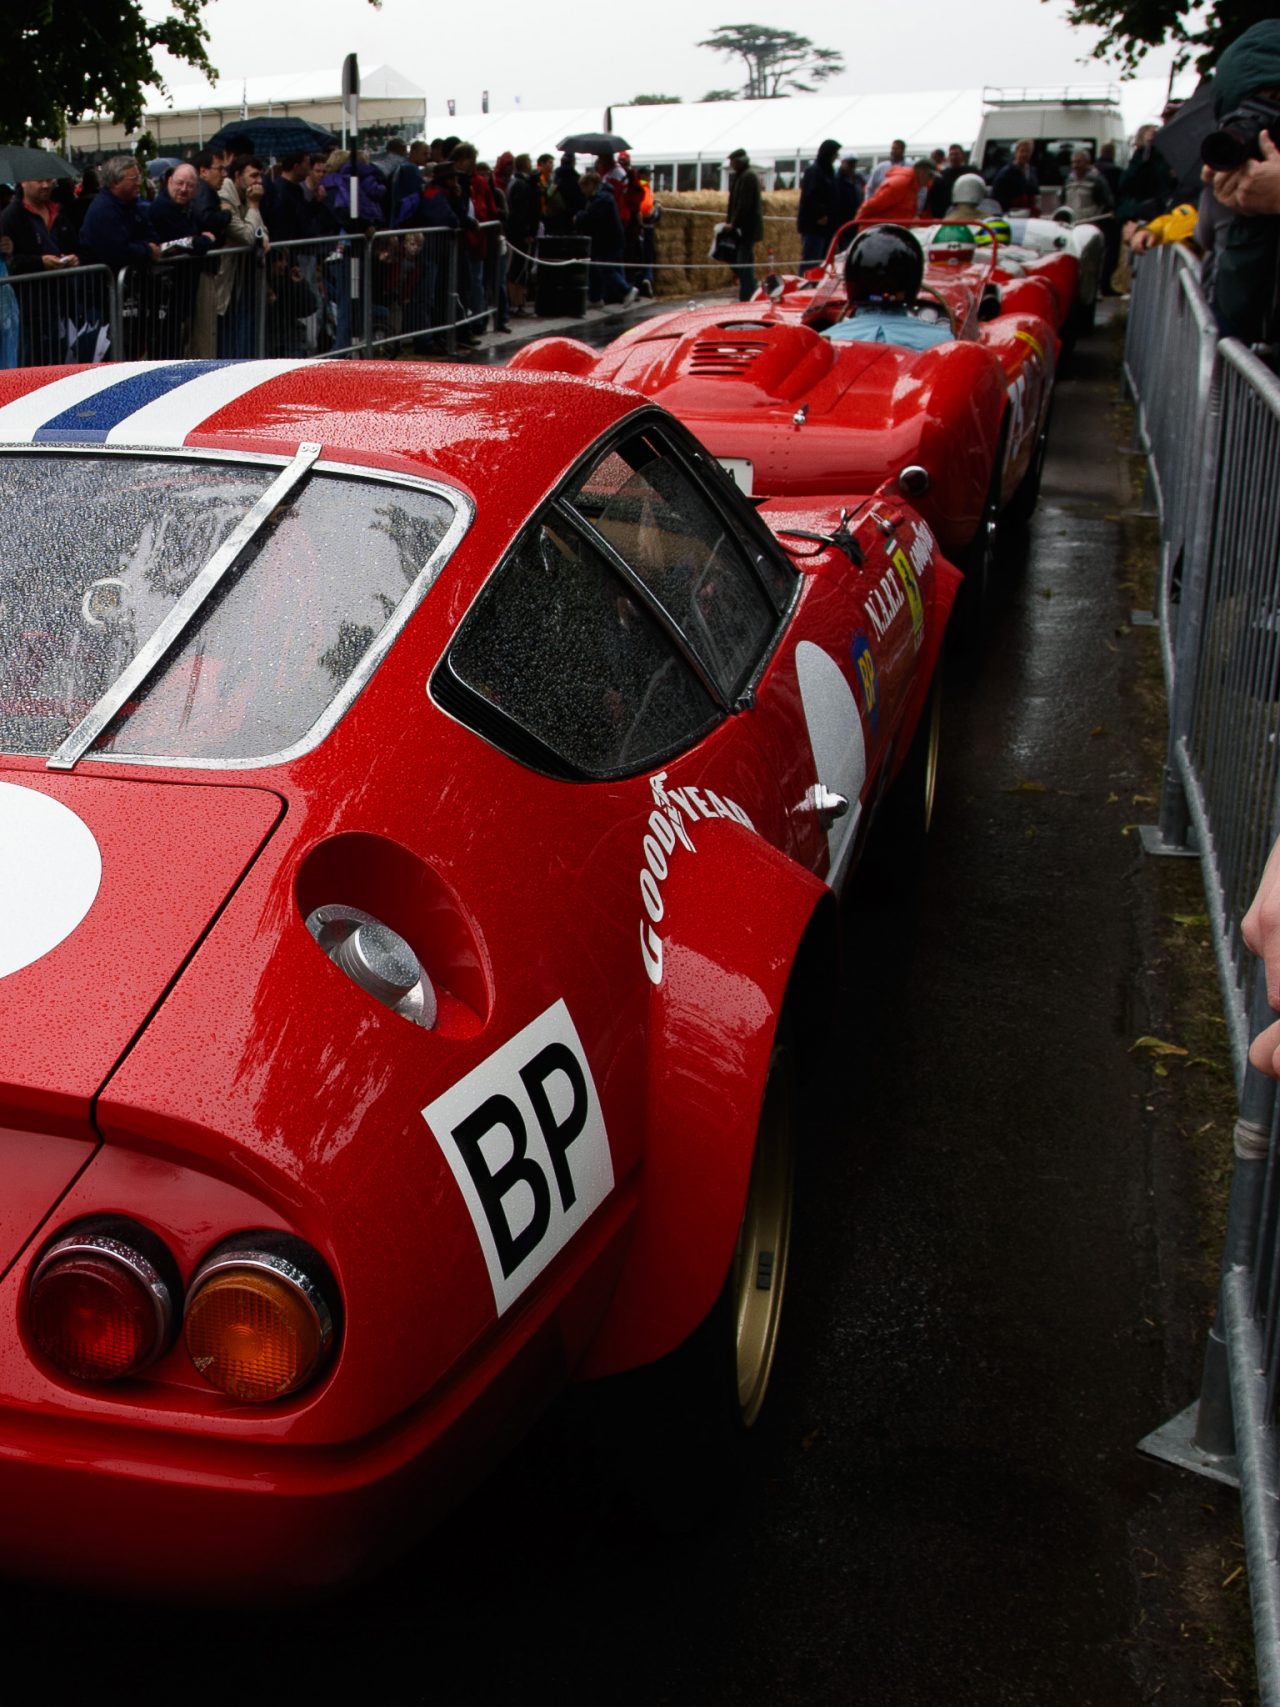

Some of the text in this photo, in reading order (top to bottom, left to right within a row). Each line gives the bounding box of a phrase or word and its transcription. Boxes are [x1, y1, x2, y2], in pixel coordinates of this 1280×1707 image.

[857, 648, 876, 713] BP
[639, 785, 761, 985] GOODYEAR
[449, 1042, 590, 1281] BP
